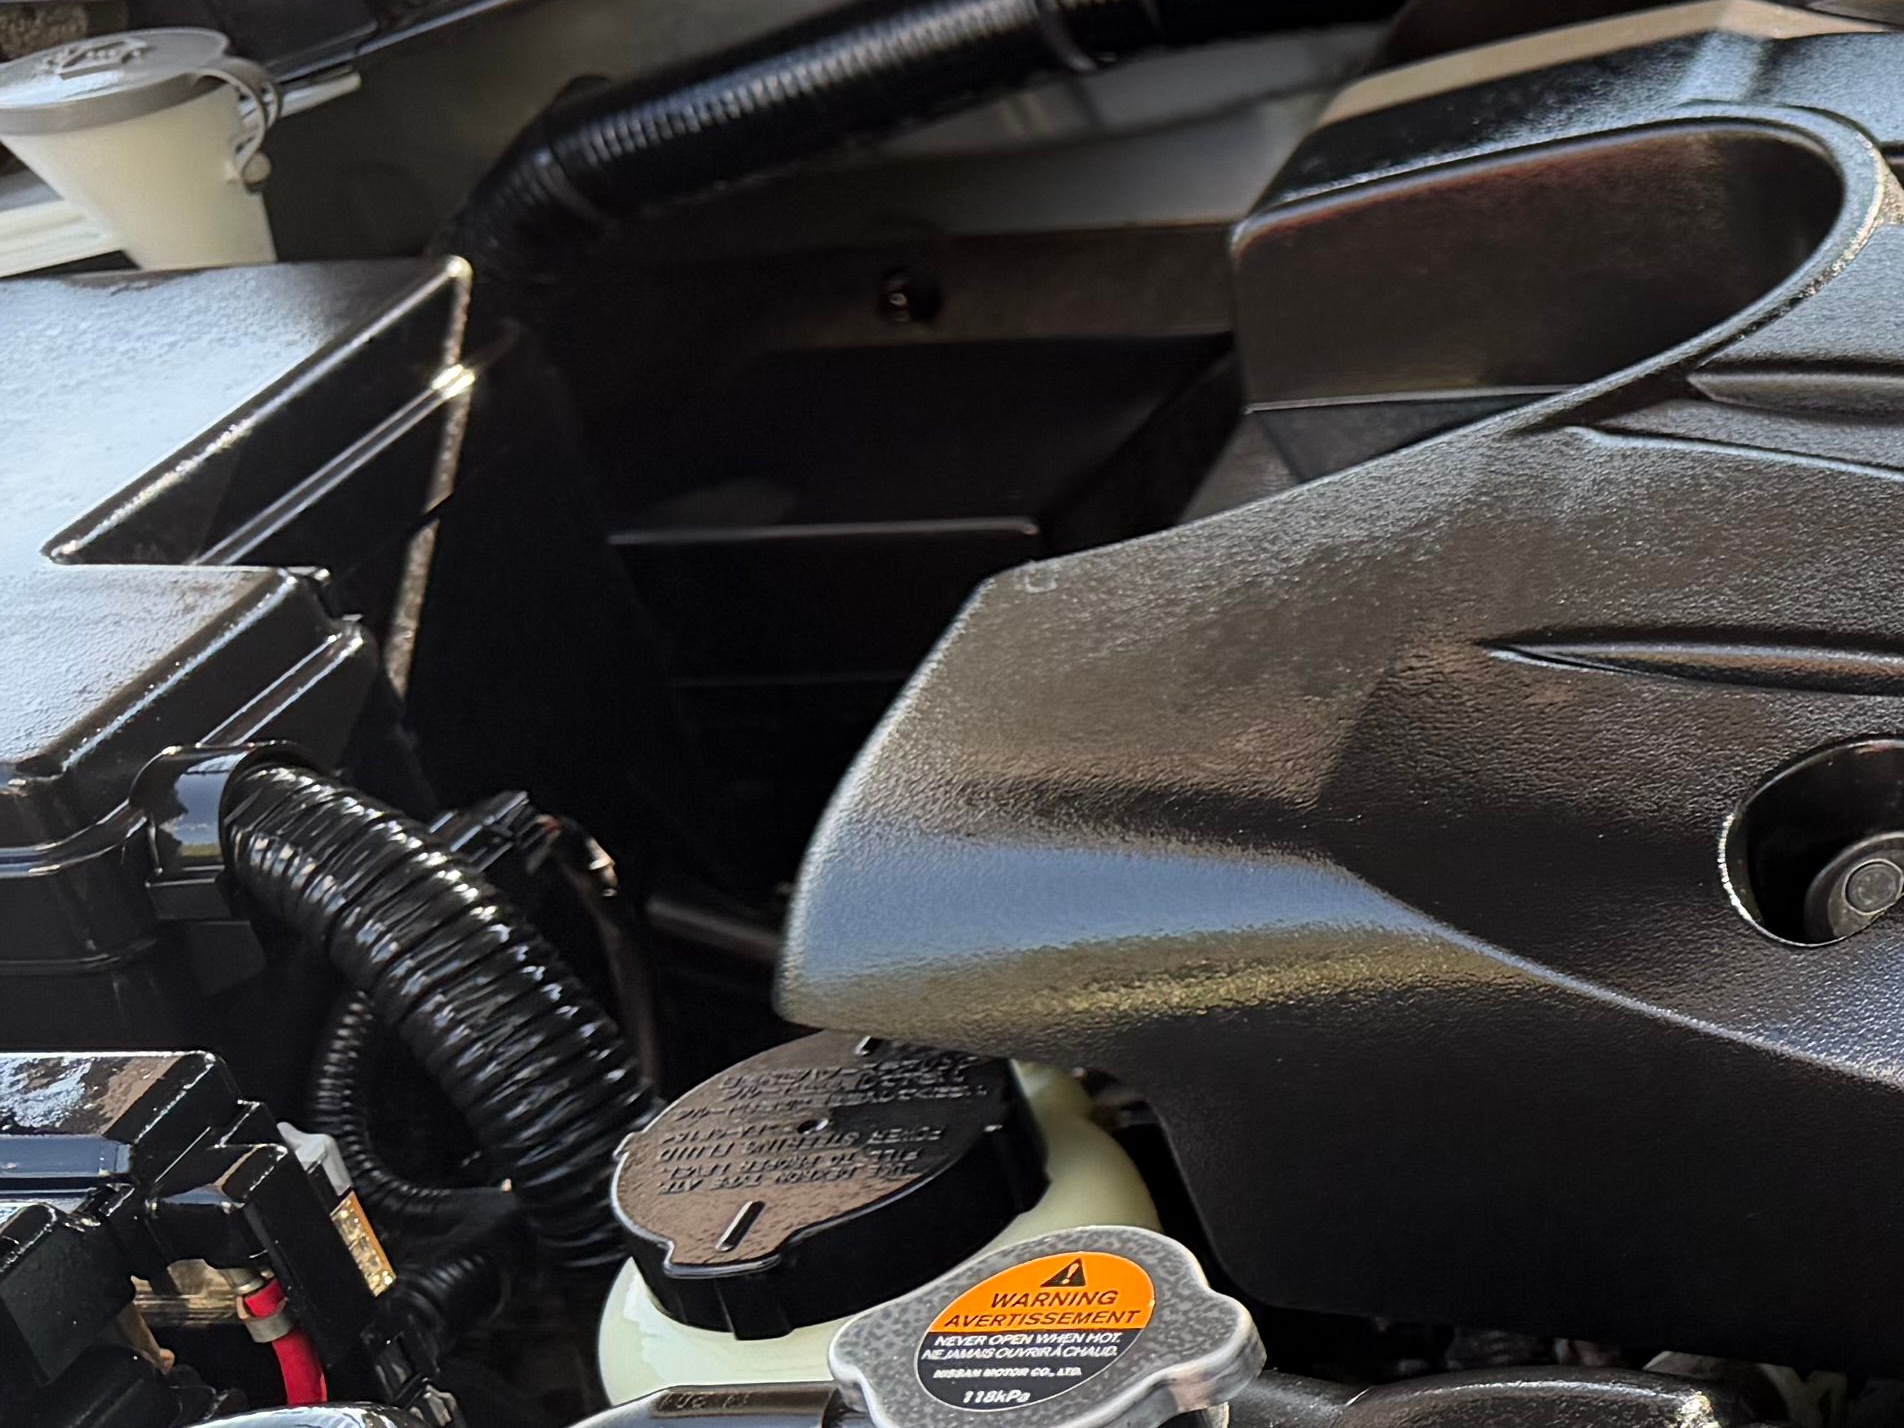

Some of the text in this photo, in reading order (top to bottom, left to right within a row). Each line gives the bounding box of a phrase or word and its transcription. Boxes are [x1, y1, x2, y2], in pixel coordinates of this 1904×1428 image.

[991, 1290, 1119, 1309] WARNING
[944, 1310, 1142, 1328] AVERTISSEMENT
[934, 1332, 1122, 1347] NEVER OPEN WHEN HOT.
[942, 1348, 995, 1360] JAMAIS
[933, 1368, 982, 1379] NISSAN
[982, 1367, 1029, 1378] MOTOR
[962, 1388, 1031, 1404] 118kPa
